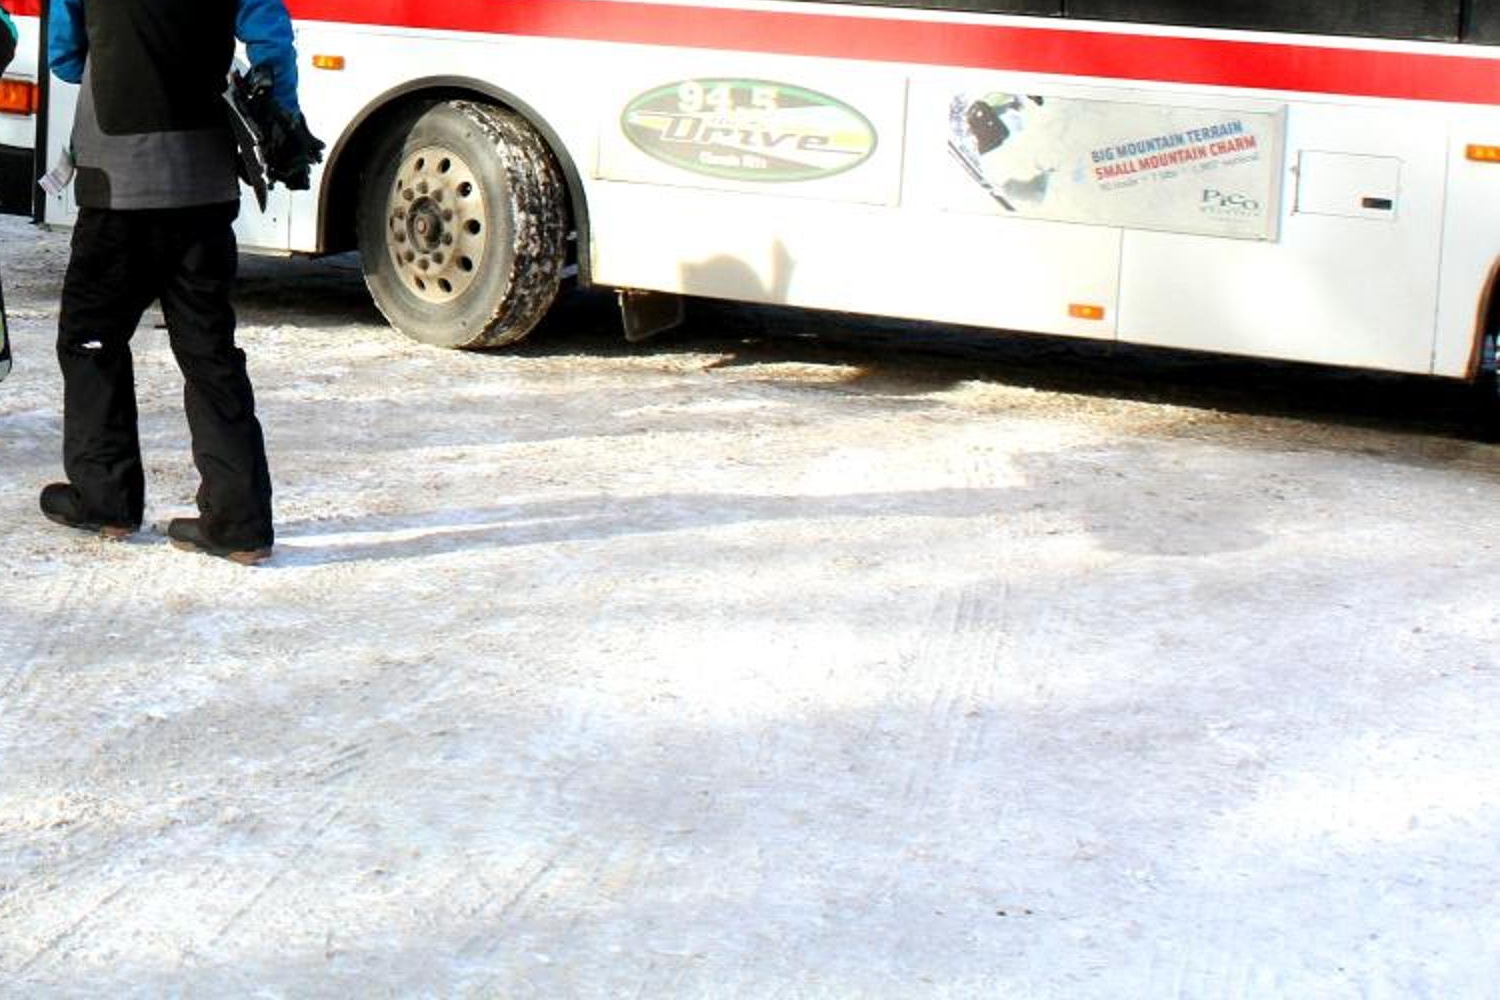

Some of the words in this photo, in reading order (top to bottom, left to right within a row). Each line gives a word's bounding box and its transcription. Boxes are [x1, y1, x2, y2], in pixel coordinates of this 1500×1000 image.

[1091, 148, 1115, 163] BIG
[1115, 132, 1185, 160] MOUNTAIN
[1186, 120, 1243, 146] TERRAIN
[1095, 160, 1137, 181] SMALL
[1138, 146, 1207, 172] MOUNTAIN
[1208, 134, 1257, 159] CHARM
